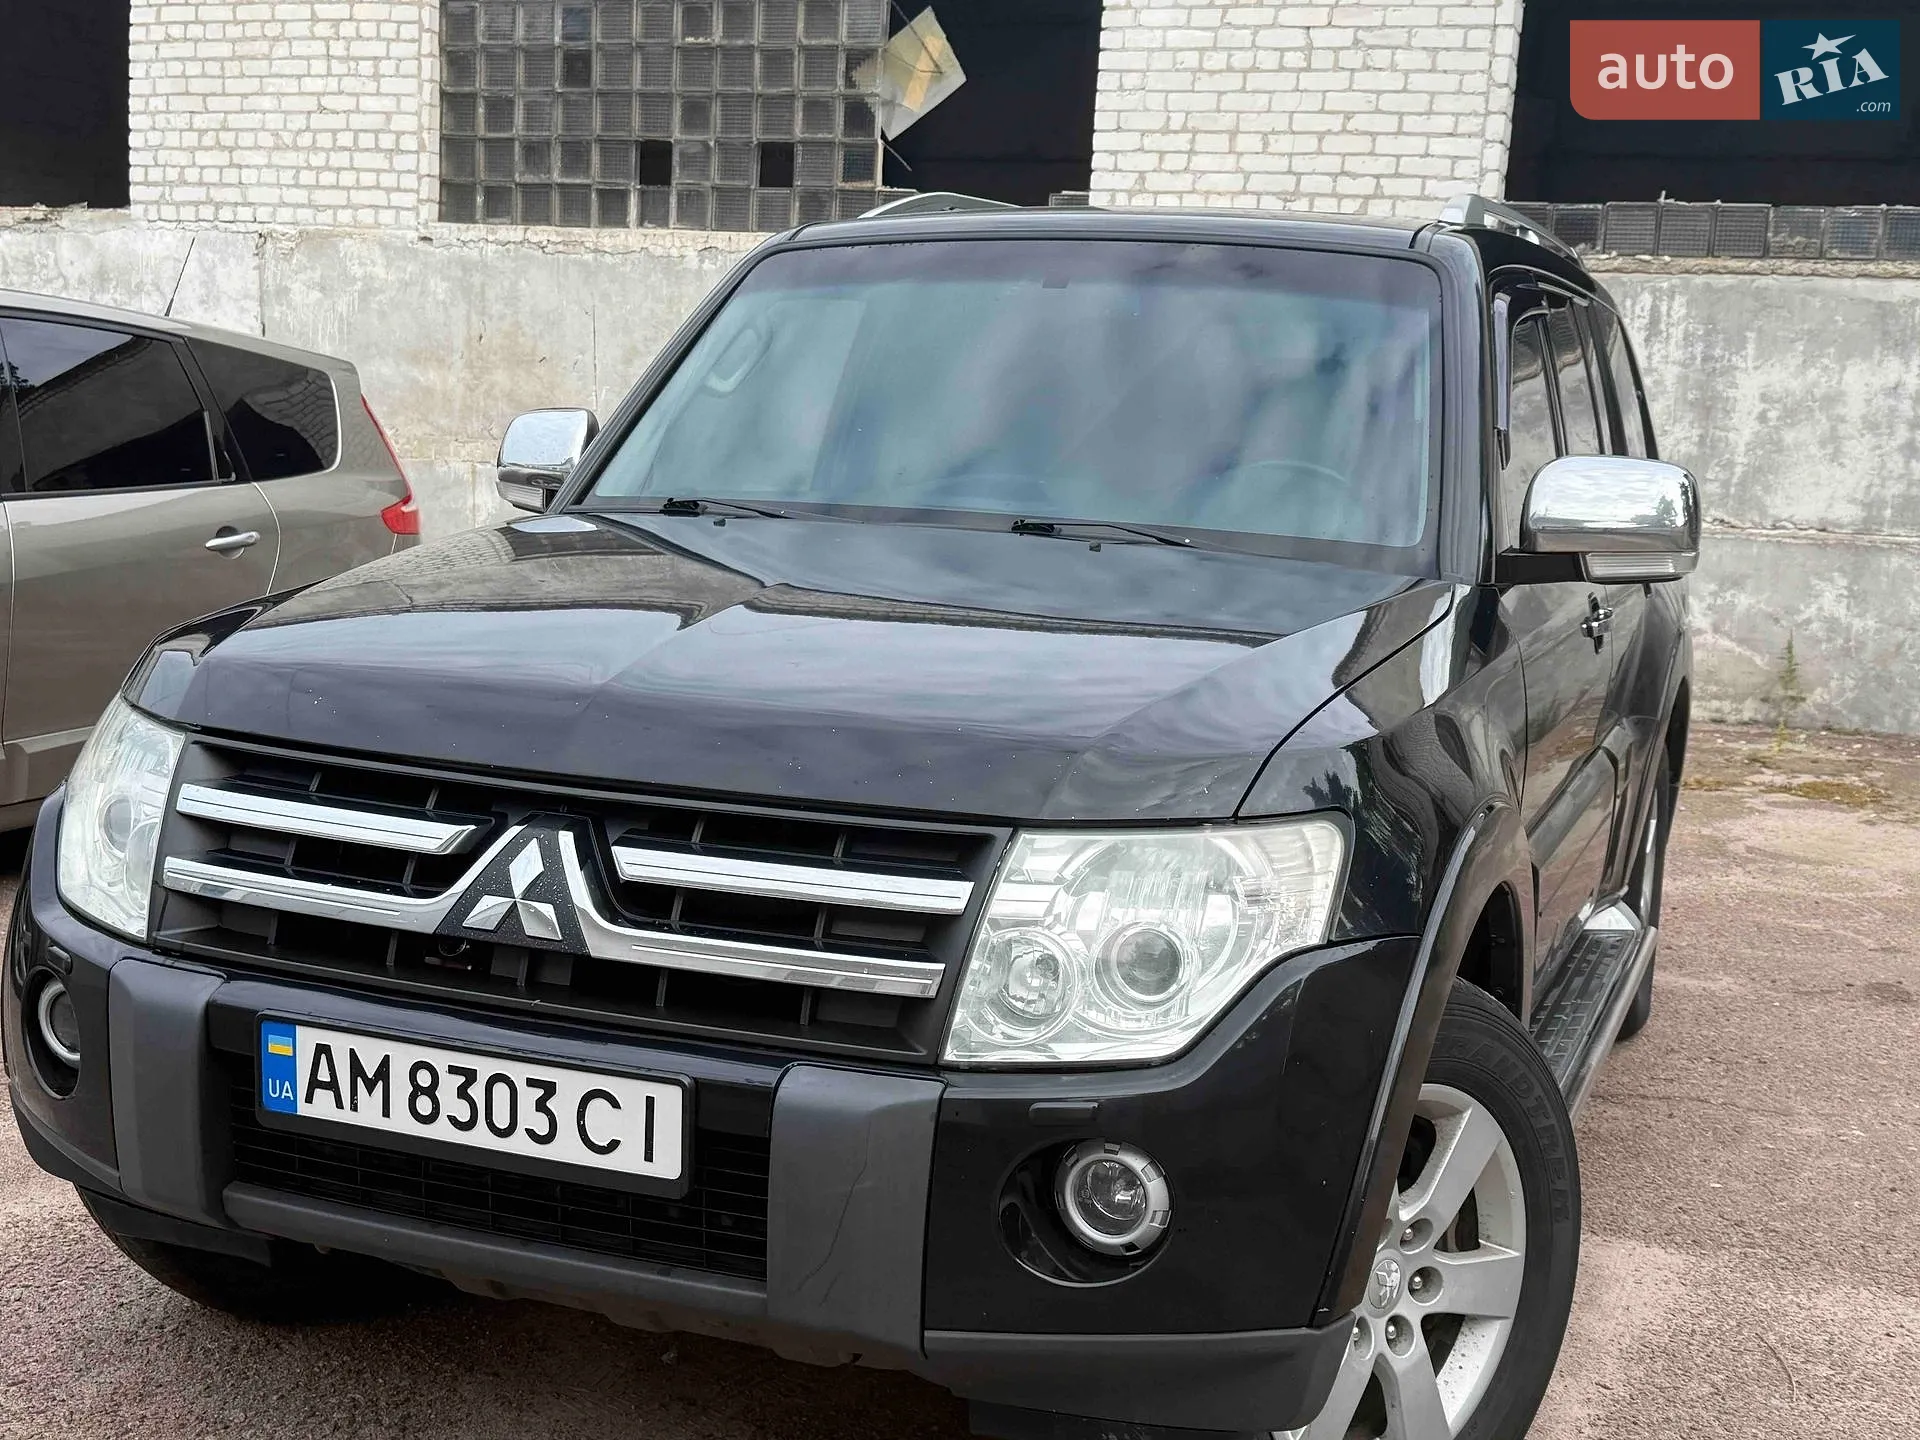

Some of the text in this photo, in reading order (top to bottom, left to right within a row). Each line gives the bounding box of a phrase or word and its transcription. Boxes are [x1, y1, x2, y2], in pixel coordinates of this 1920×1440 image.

[269, 1078, 294, 1101] UA
[305, 1043, 655, 1163] AM 8303 CI
